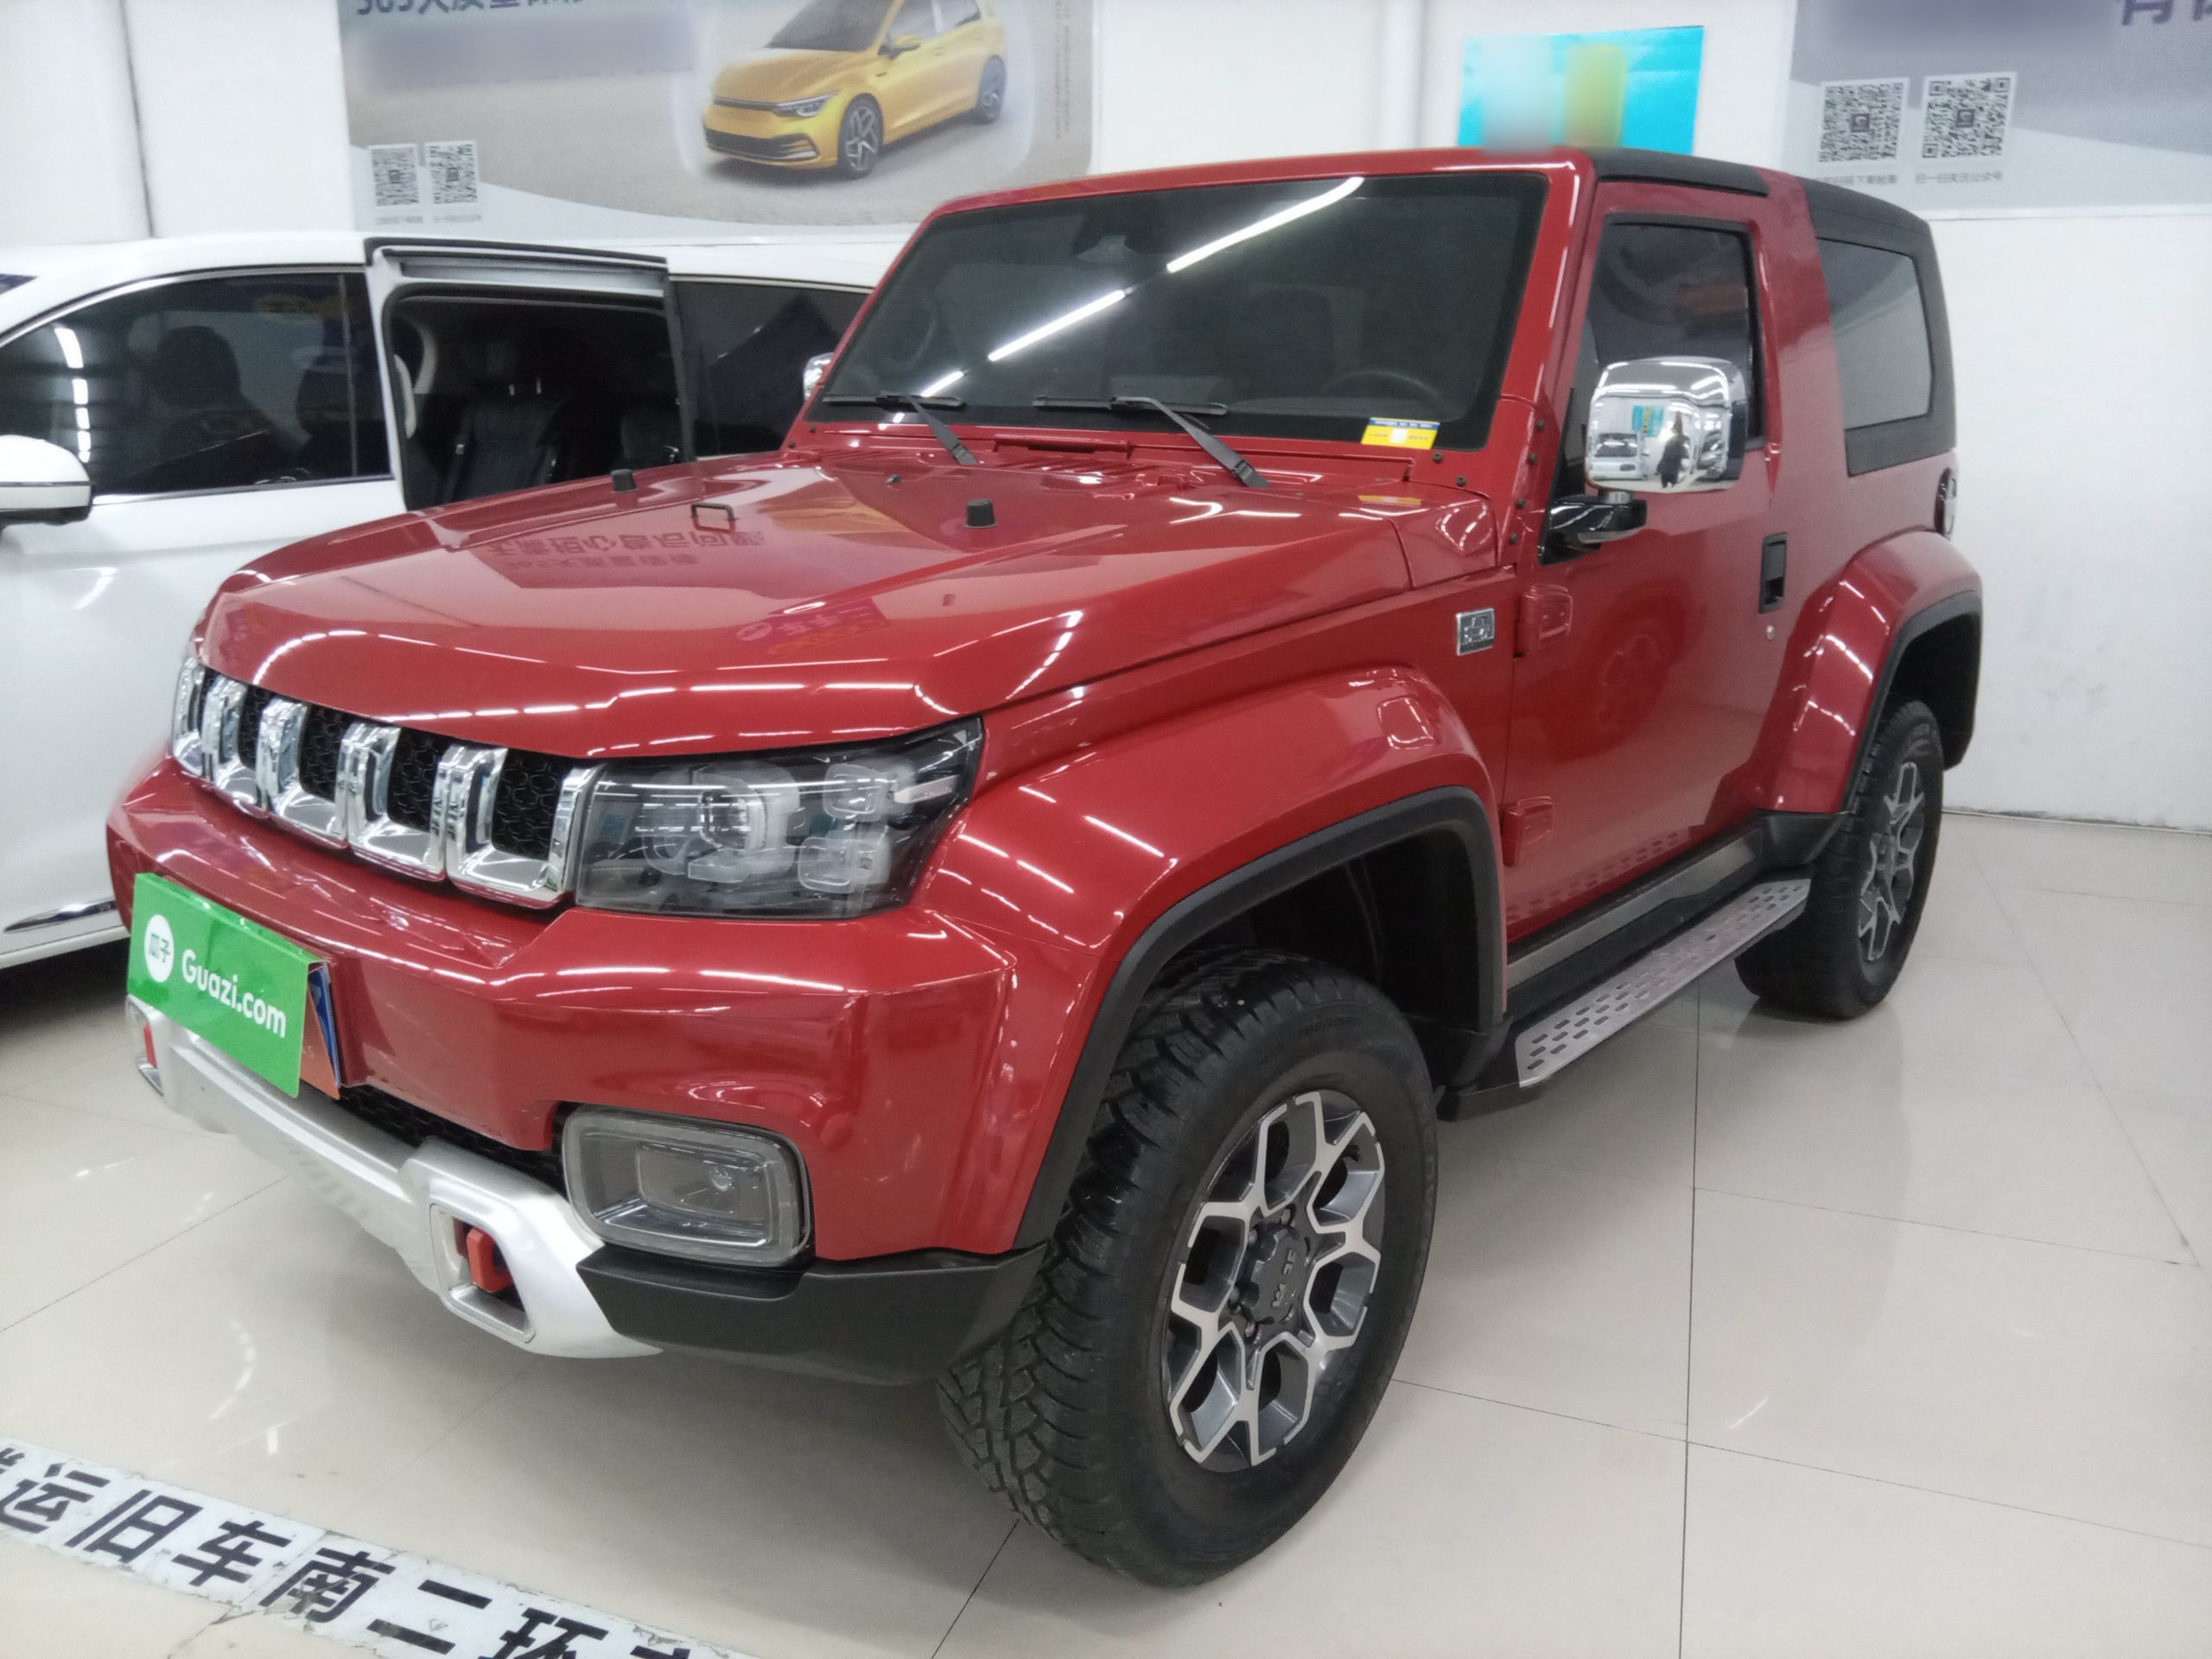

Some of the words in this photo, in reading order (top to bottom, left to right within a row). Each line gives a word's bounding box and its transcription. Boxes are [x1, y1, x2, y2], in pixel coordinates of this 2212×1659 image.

[181, 949, 287, 1039] Guazi.com
[0, 1447, 690, 1659] 运旧车南二环
